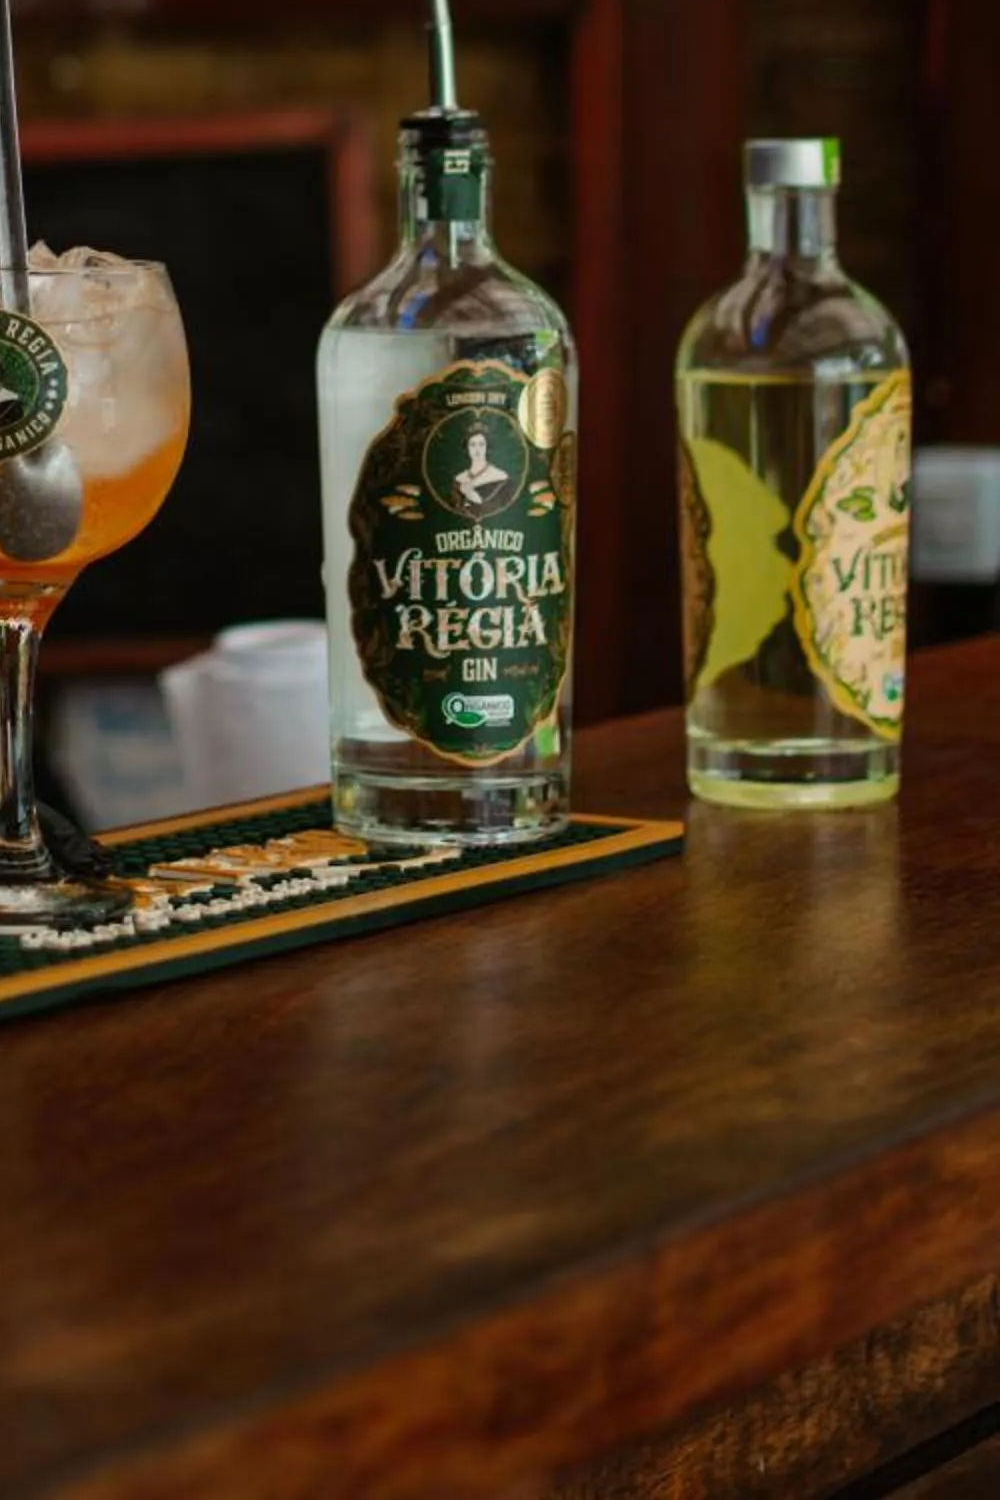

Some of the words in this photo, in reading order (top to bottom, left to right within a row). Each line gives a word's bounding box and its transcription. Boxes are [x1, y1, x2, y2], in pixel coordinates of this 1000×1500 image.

[5, 318, 59, 375] REGIA
[436, 524, 524, 553] ORGÂNICO
[462, 657, 498, 682] GIN
